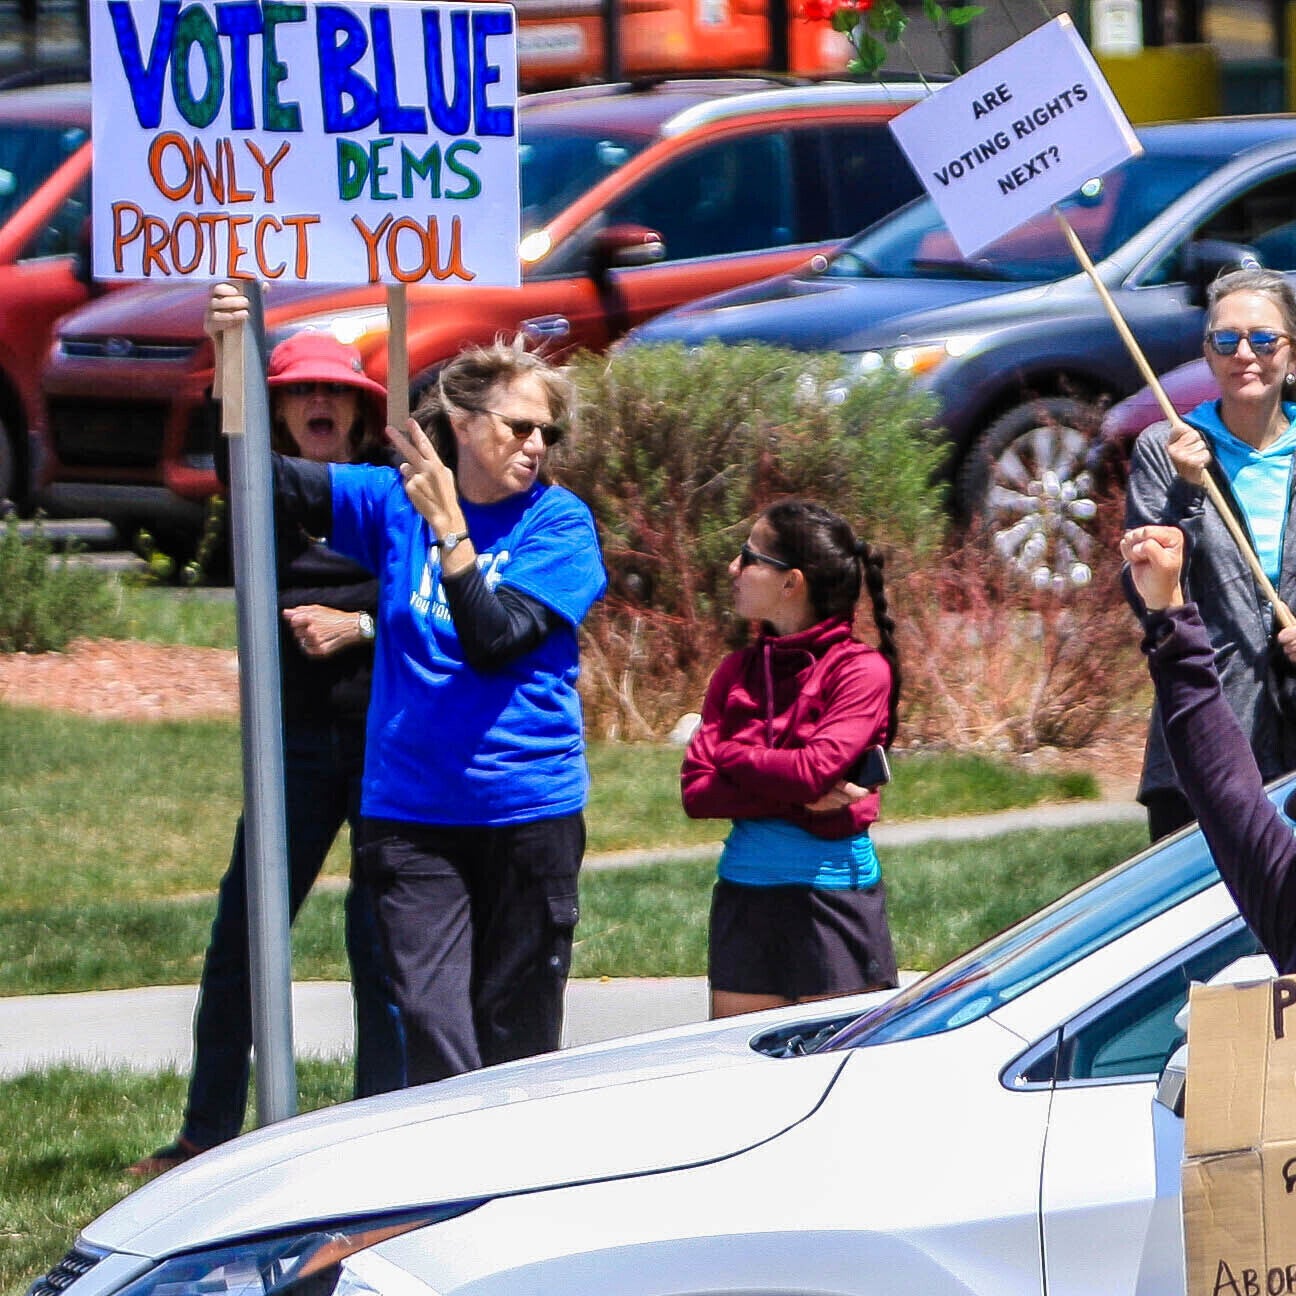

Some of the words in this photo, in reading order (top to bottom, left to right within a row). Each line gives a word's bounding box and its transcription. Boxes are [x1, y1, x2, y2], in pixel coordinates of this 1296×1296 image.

[111, 0, 307, 130] VOTE
[316, 5, 514, 136] BLUE
[972, 83, 1013, 120] ARE
[148, 131, 290, 203] ONLY
[336, 137, 482, 200] DEMS
[933, 131, 1011, 186] VOTING
[1012, 83, 1088, 140] RIGHTS
[997, 145, 1061, 195] NEXT?
[111, 202, 320, 279] PROTECT
[352, 214, 475, 283] YOU
